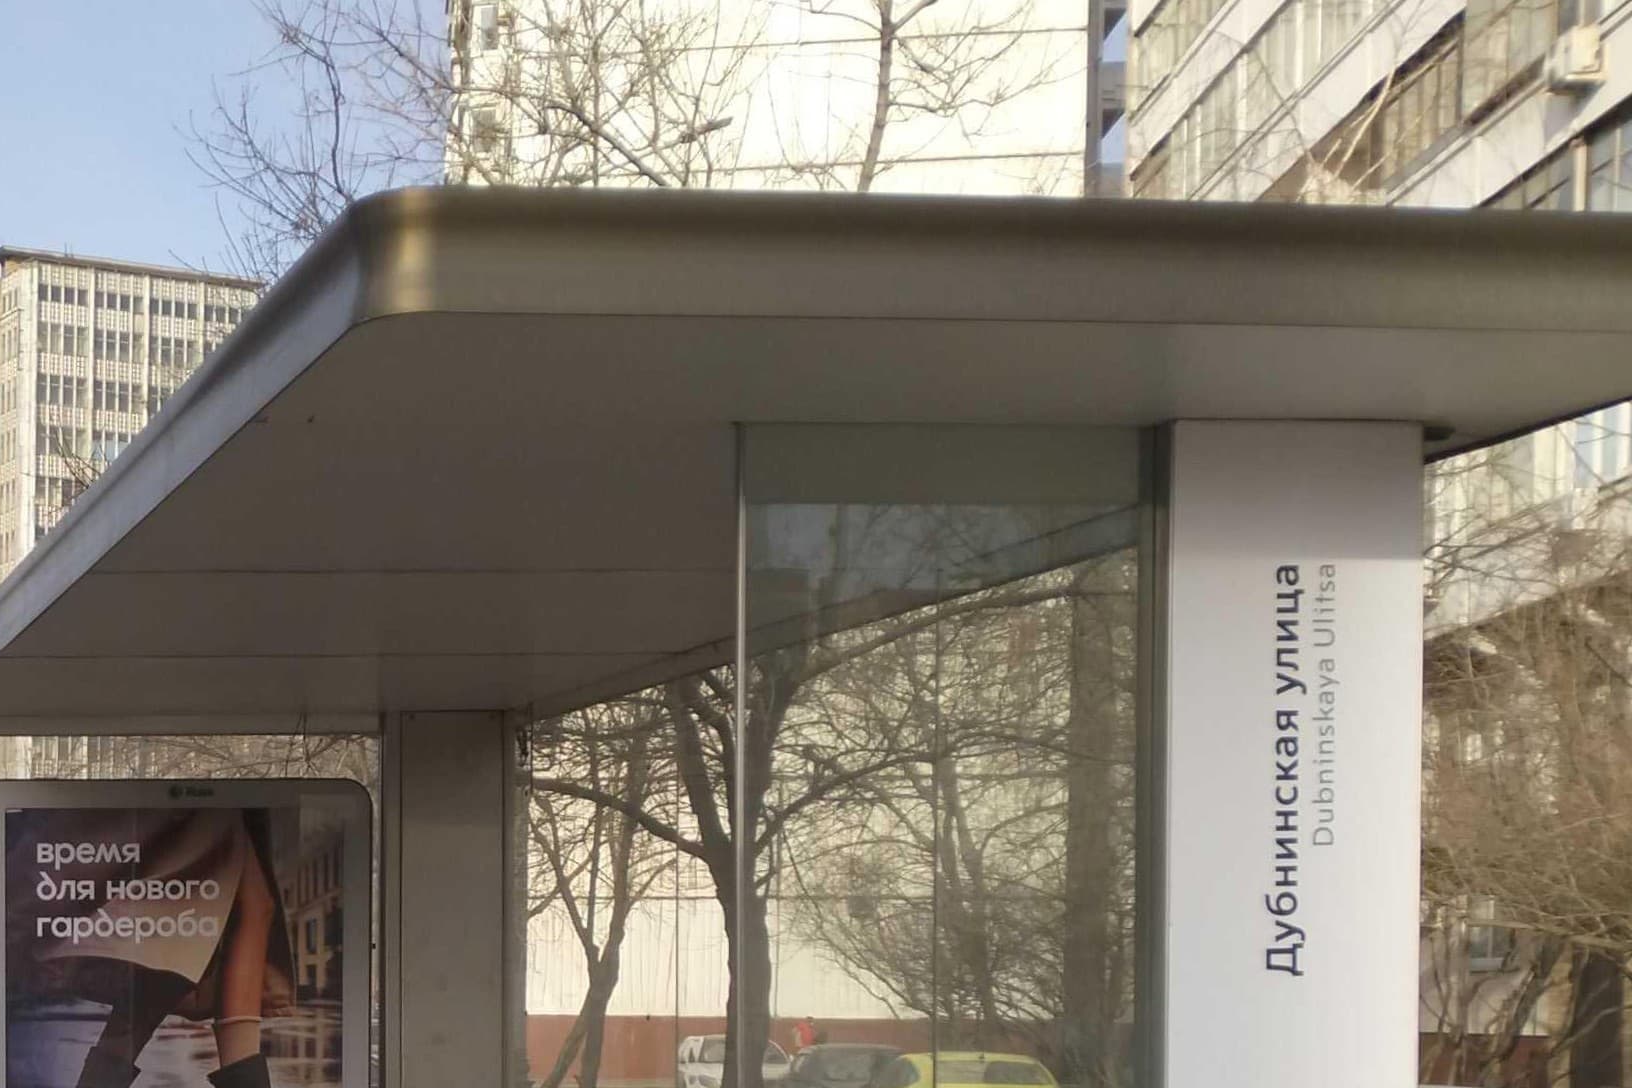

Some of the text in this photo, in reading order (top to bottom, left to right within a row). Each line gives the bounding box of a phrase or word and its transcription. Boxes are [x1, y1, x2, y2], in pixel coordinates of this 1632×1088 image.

[1312, 563, 1341, 846] Dubninskaya Ulitsa
[1265, 564, 1307, 976] Дубнинская улица
[36, 842, 141, 871] время
[36, 871, 221, 901] для нового
[36, 908, 219, 945] гардероба
